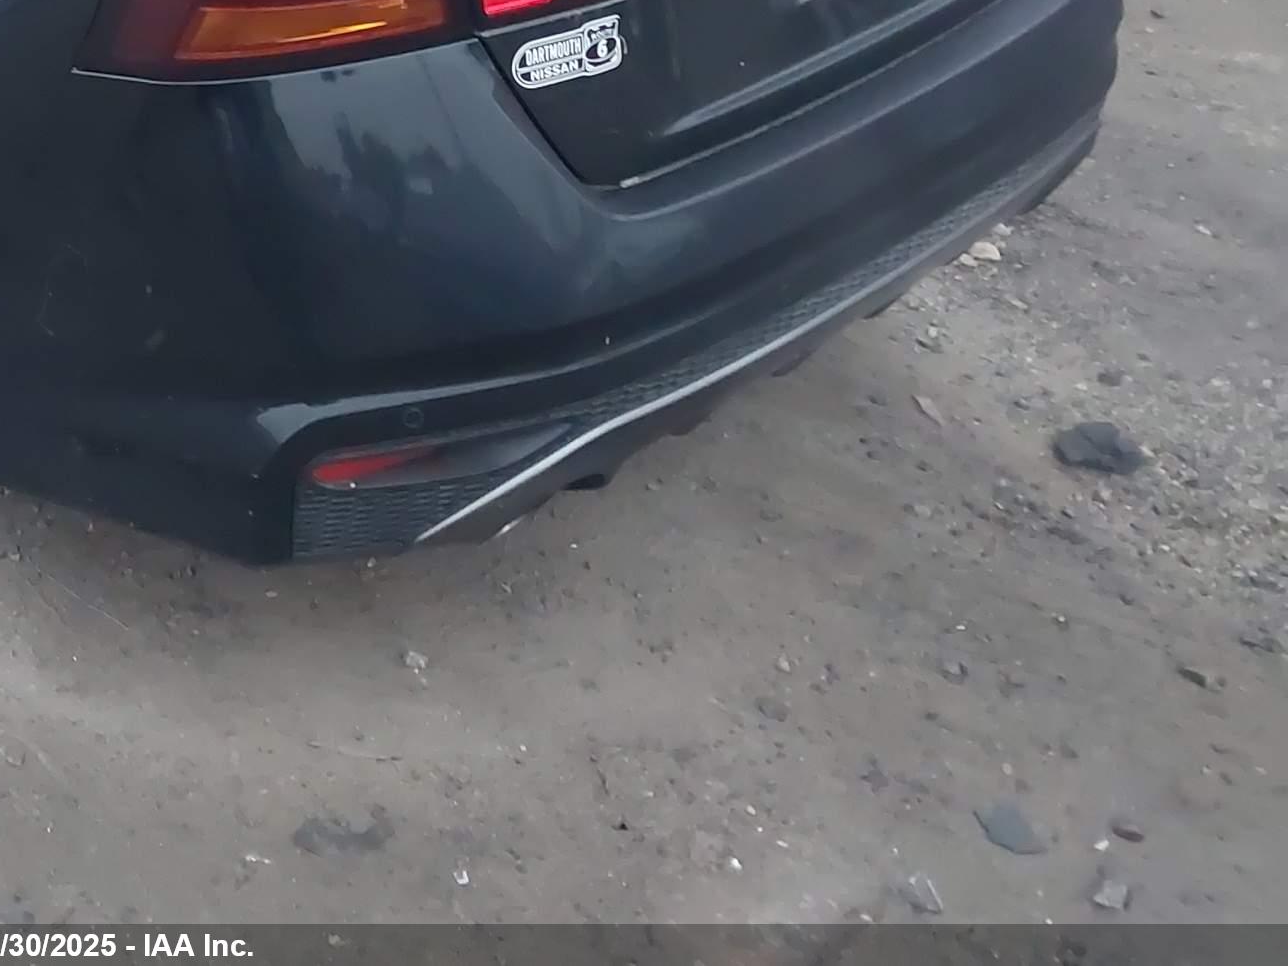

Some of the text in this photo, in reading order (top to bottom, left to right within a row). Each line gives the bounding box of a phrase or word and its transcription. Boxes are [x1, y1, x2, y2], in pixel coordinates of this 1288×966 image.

[525, 36, 582, 67] DARTMOUTH
[596, 38, 609, 59] 6
[529, 59, 580, 83] NISSAN
